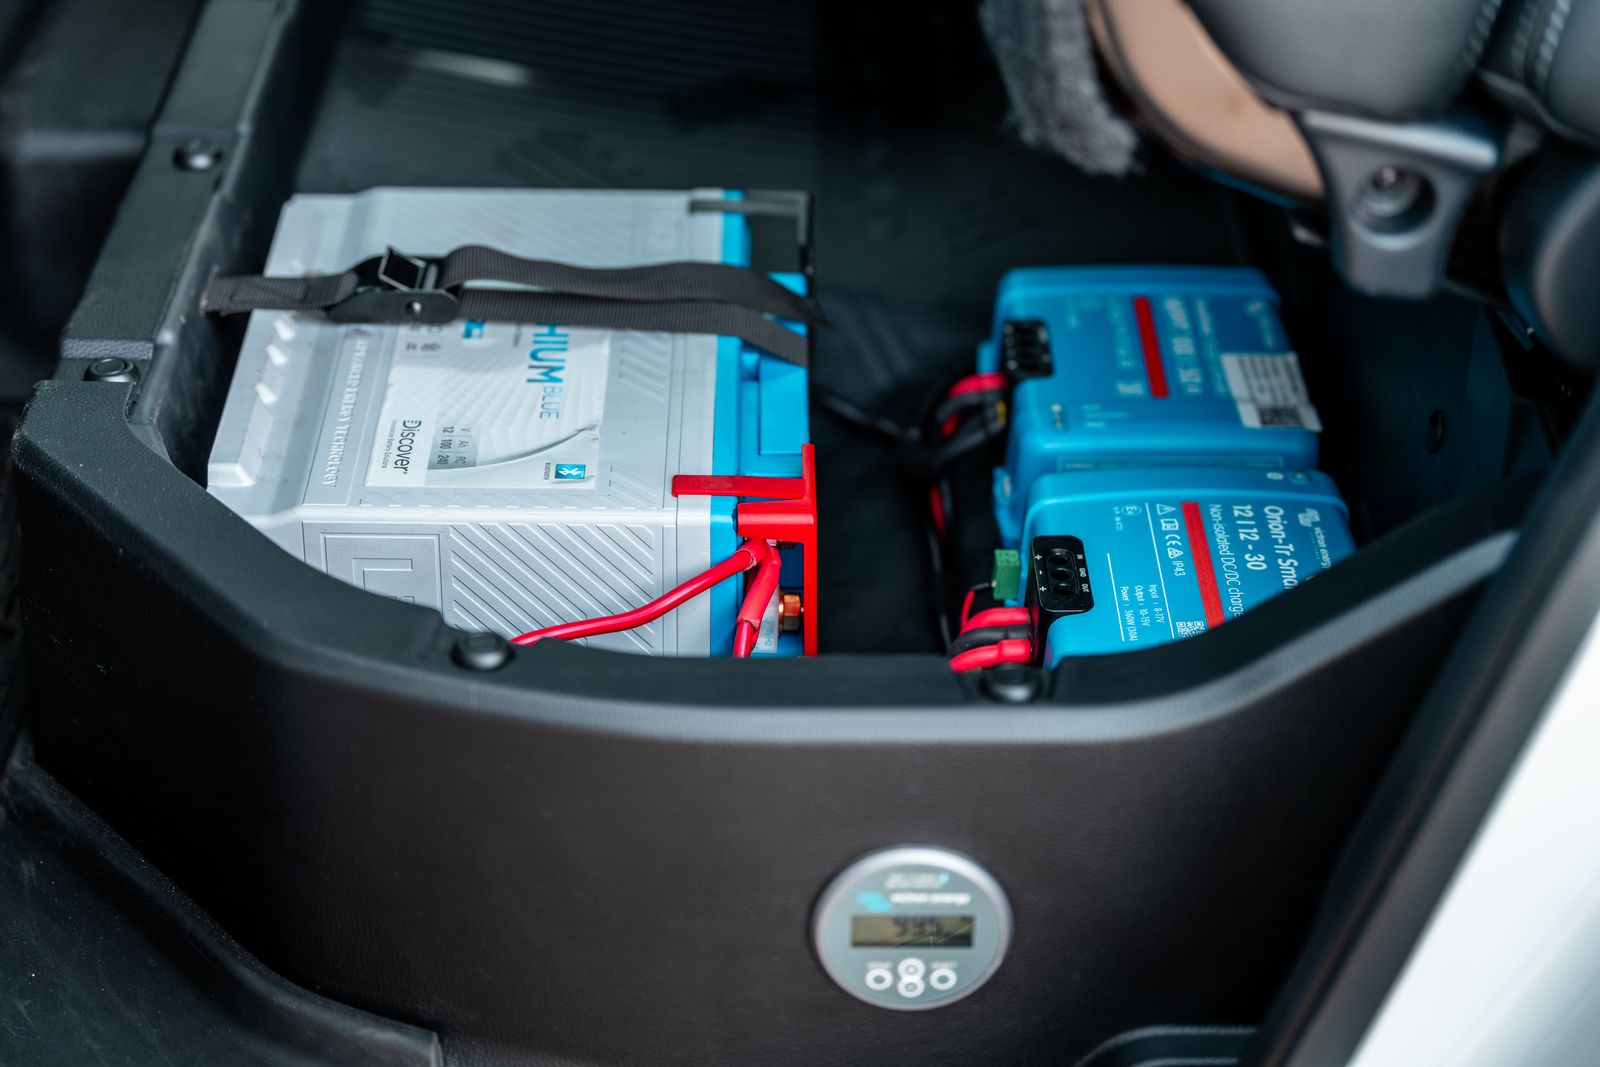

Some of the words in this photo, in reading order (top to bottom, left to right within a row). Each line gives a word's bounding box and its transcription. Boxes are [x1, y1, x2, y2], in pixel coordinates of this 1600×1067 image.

[539, 385, 563, 419] BLUE
[443, 426, 454, 434] 12
[394, 420, 422, 472] Discover
[440, 439, 452, 449] 100
[322, 424, 349, 486] TECHNOLOGY
[437, 454, 450, 465] 240
[1233, 505, 1255, 518] 12
[1208, 504, 1235, 556] Non-isolated
[1238, 528, 1260, 541] 12
[1264, 505, 1295, 556] Orion-Tr
[1172, 561, 1186, 576] IP43
[1245, 553, 1267, 570] 30
[1220, 557, 1241, 586] DC/DC
[1120, 586, 1130, 601] Power
[1134, 585, 1146, 602] Output
[1149, 584, 1160, 600] Input
[1124, 610, 1136, 625] 360W
[1139, 609, 1151, 626] 10-15V
[1153, 607, 1165, 623] 8-17V
